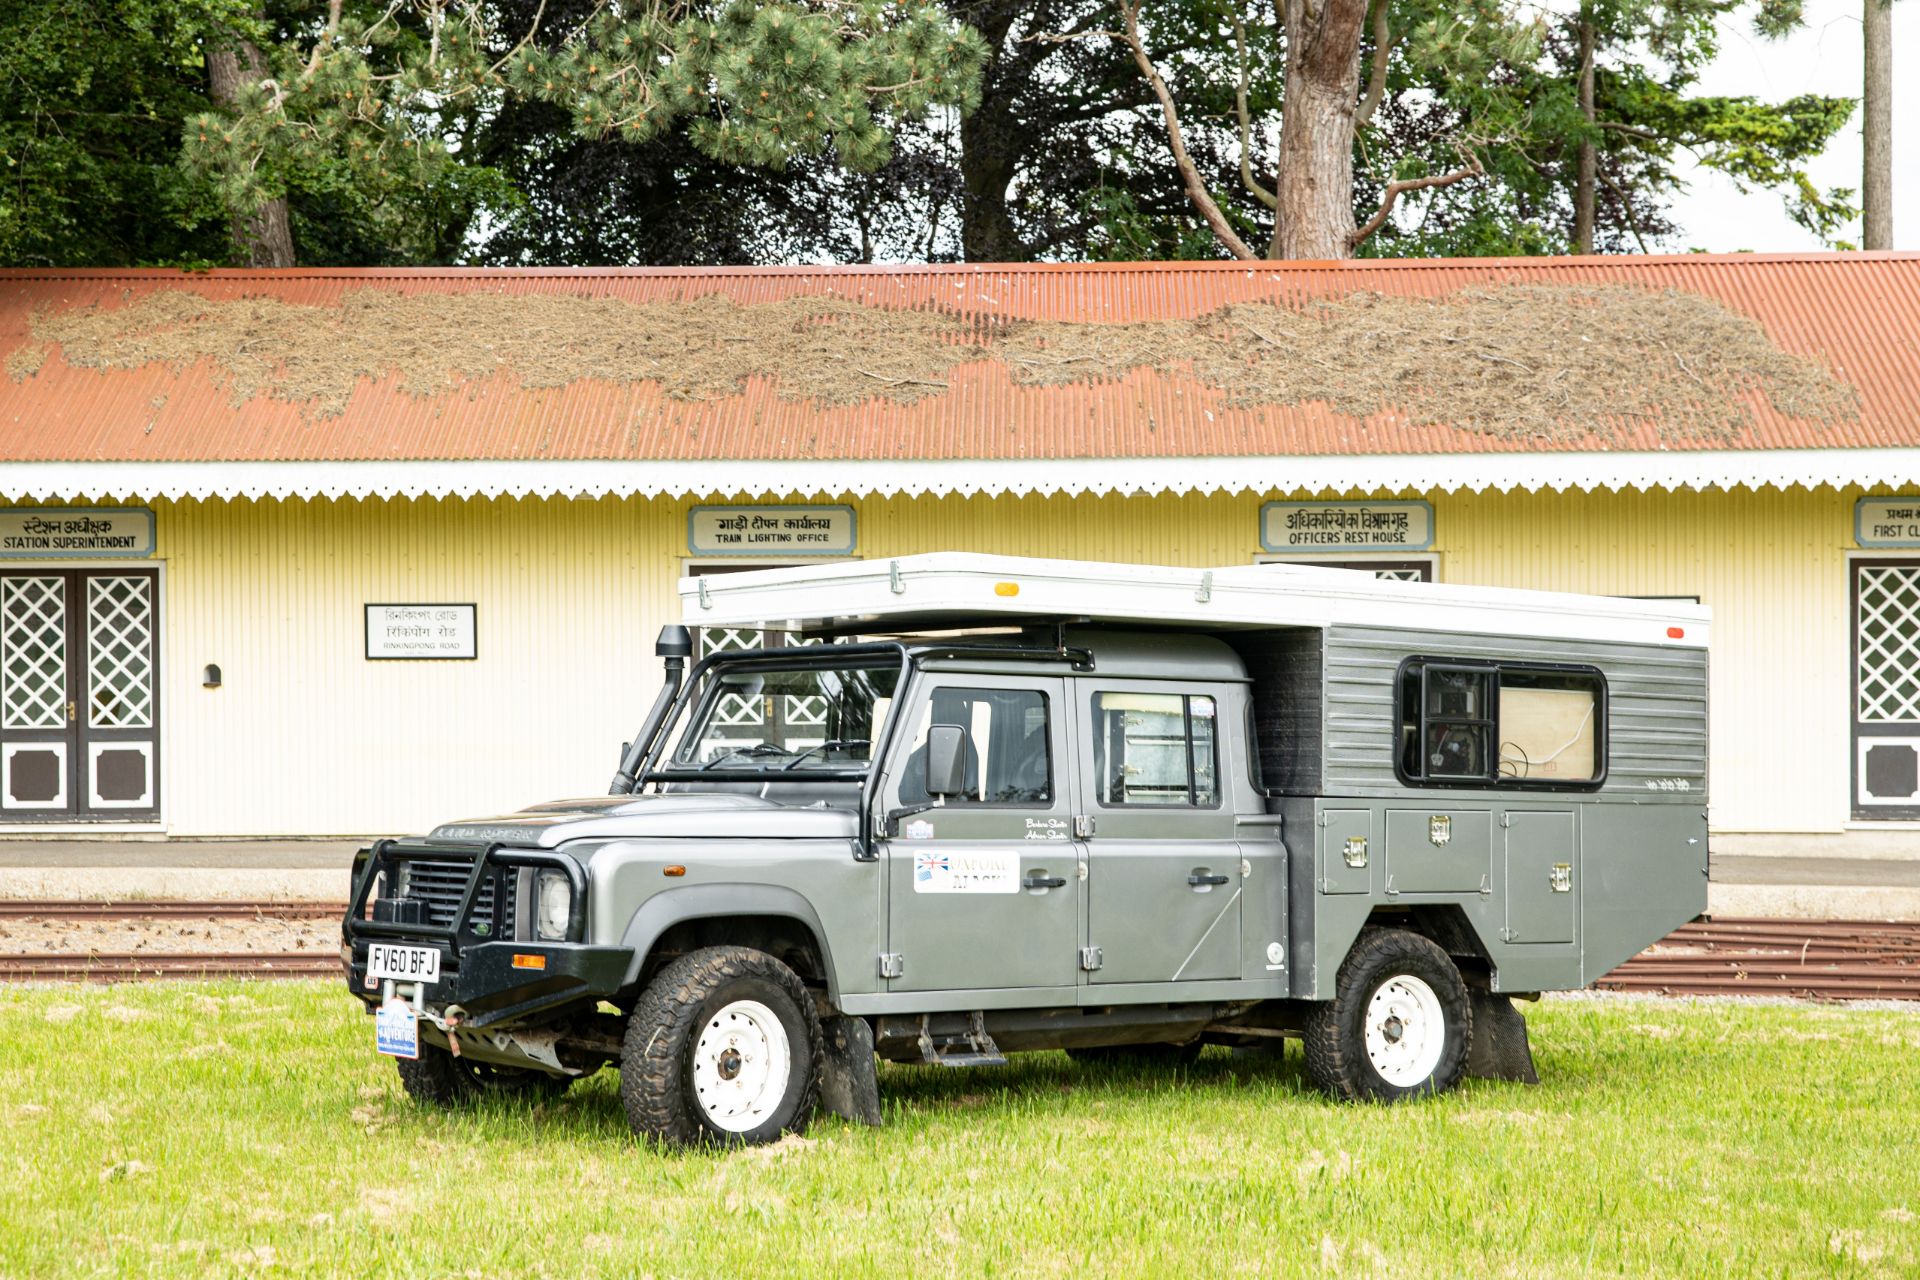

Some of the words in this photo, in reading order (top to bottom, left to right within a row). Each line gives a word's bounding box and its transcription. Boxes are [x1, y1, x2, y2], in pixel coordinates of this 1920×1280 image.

[22, 516, 62, 535] स्टेशन
[63, 517, 113, 536] अधीक्षक
[717, 515, 749, 532] गाड़ी
[752, 516, 779, 529] दीपन
[784, 515, 831, 529] कार्यालय
[1344, 531, 1370, 543] REST
[1372, 531, 1406, 543] HOUSE
[1873, 525, 1904, 537] FIRST
[3, 537, 50, 549] STATION
[52, 536, 136, 549] SUPERINTENDENT
[715, 534, 742, 543] TRAIN
[748, 533, 791, 543] LIGHTING
[797, 533, 829, 542] OFFICE
[383, 642, 436, 650] RINKINGPONG
[439, 642, 460, 650] ROAD
[373, 947, 407, 973] FV60
[410, 950, 436, 976] BFJ
